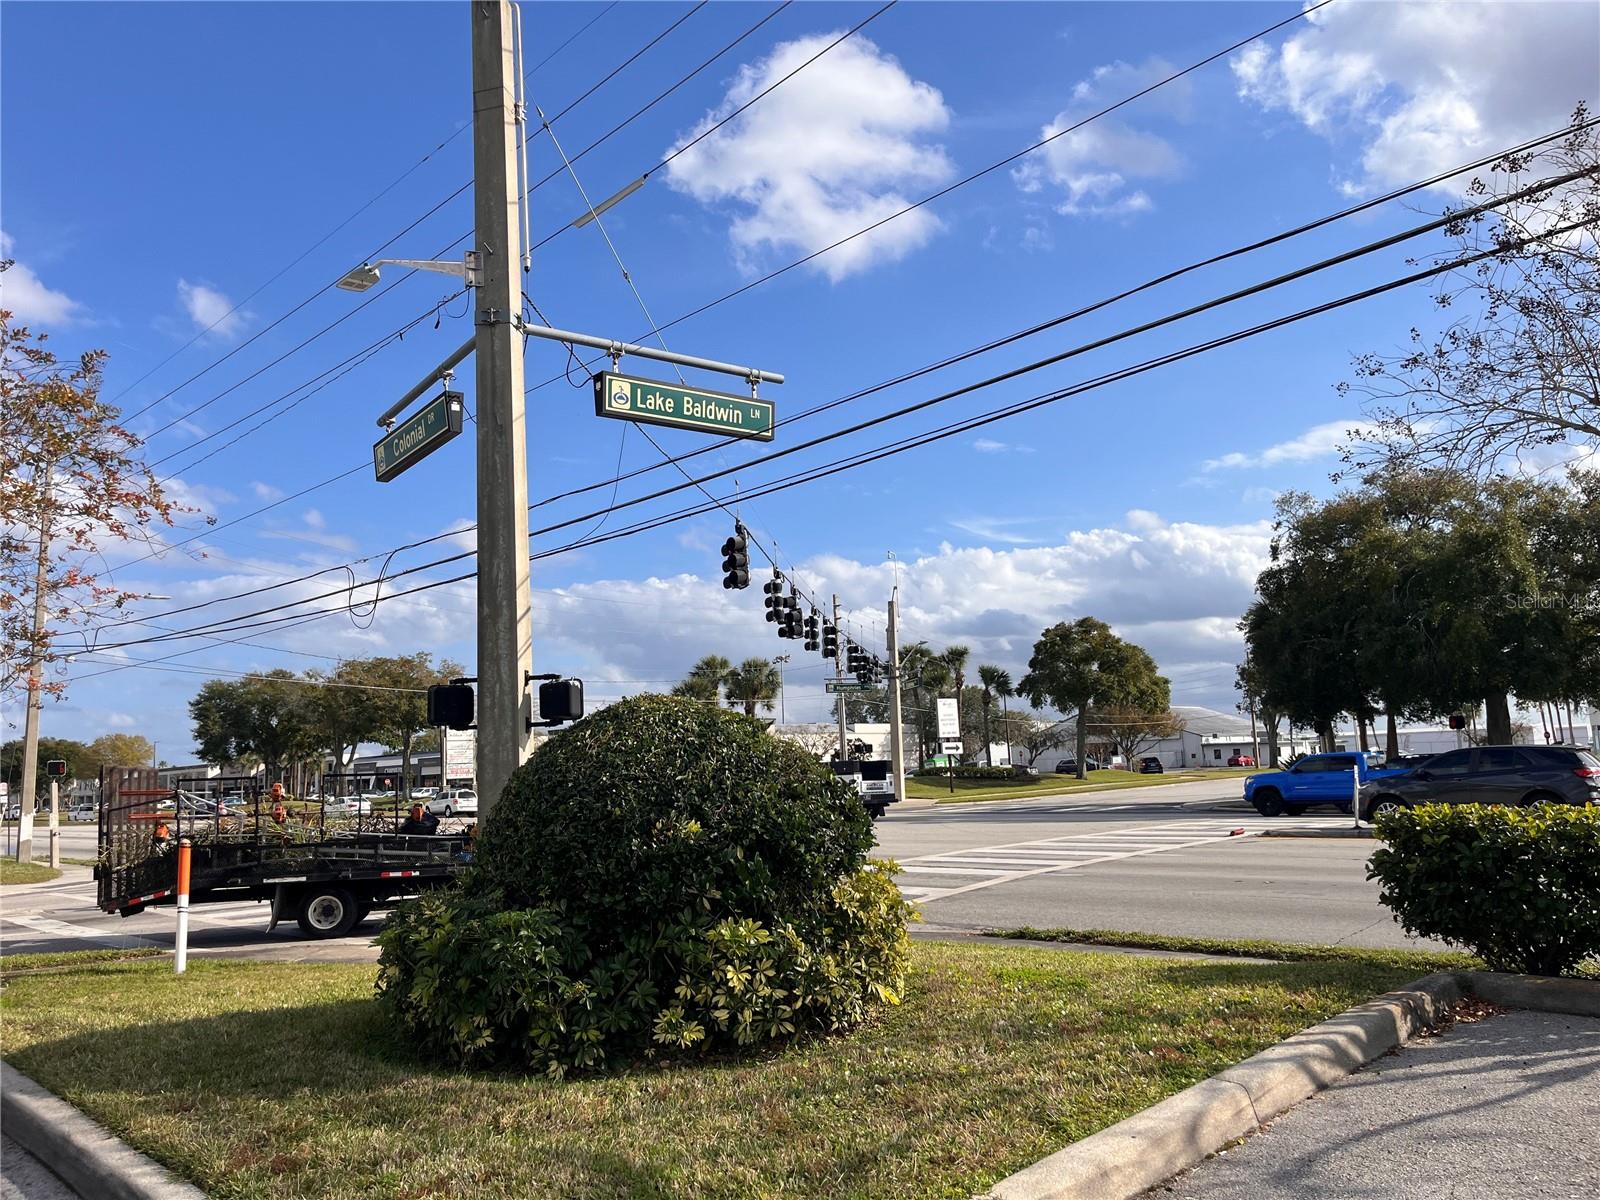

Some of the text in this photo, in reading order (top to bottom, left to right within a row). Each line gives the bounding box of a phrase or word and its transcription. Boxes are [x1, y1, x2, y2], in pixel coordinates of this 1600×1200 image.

[636, 388, 761, 424] Lake Baldwin LN
[393, 412, 435, 456] Colonial DR
